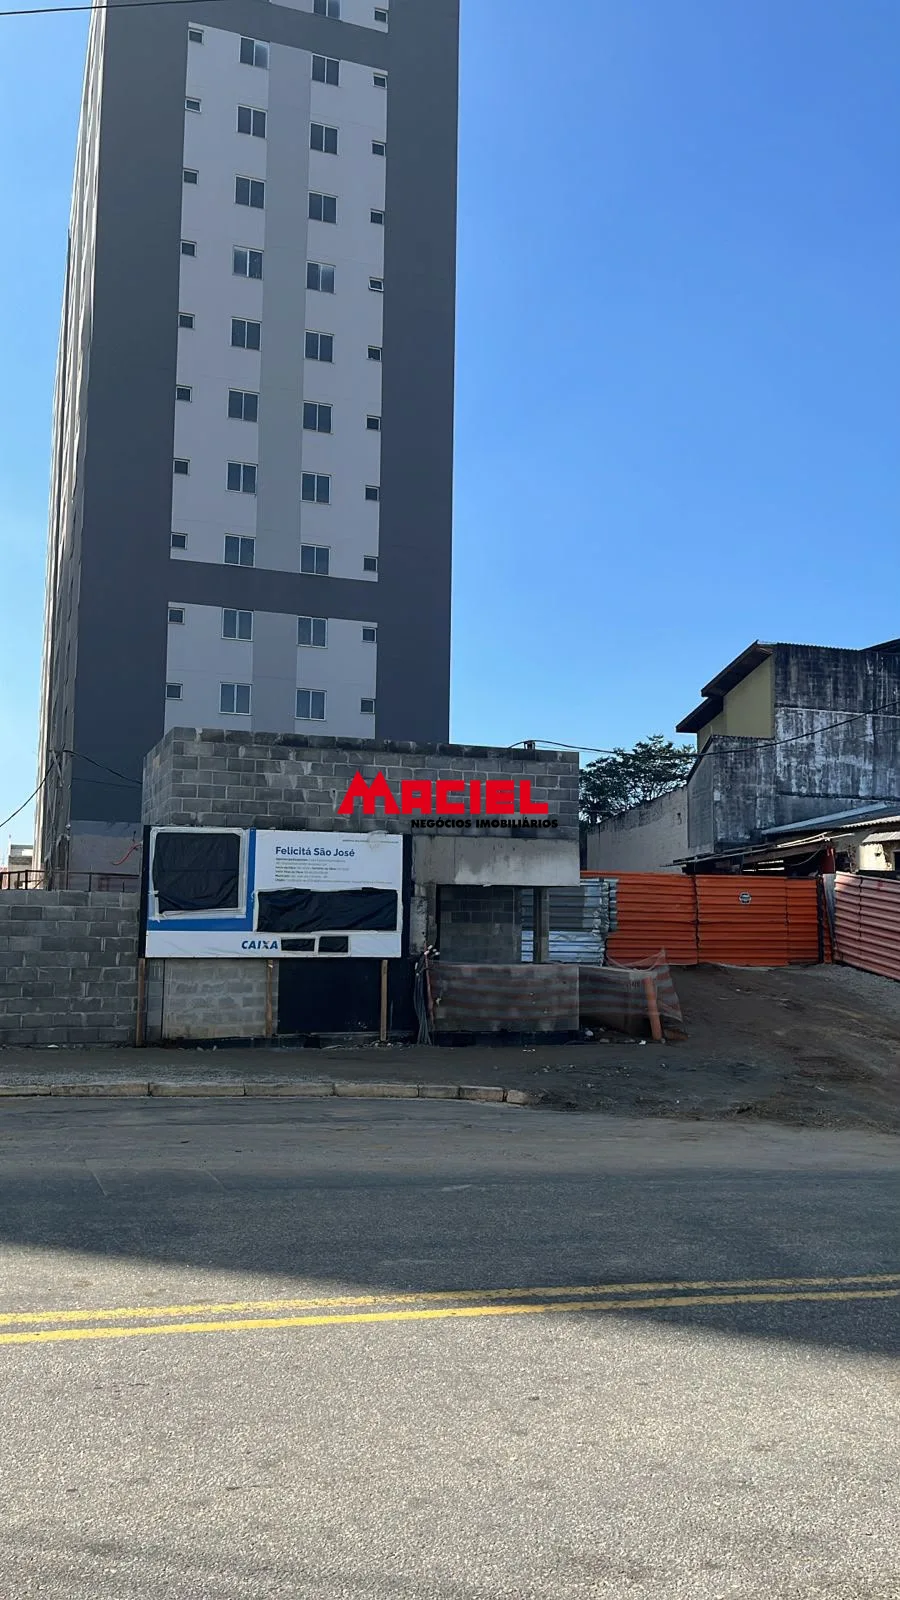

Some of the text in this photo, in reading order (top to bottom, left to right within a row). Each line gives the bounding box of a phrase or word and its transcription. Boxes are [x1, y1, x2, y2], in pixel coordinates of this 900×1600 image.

[275, 846, 355, 858] Felicitá São José
[241, 940, 279, 950] CAIXA
